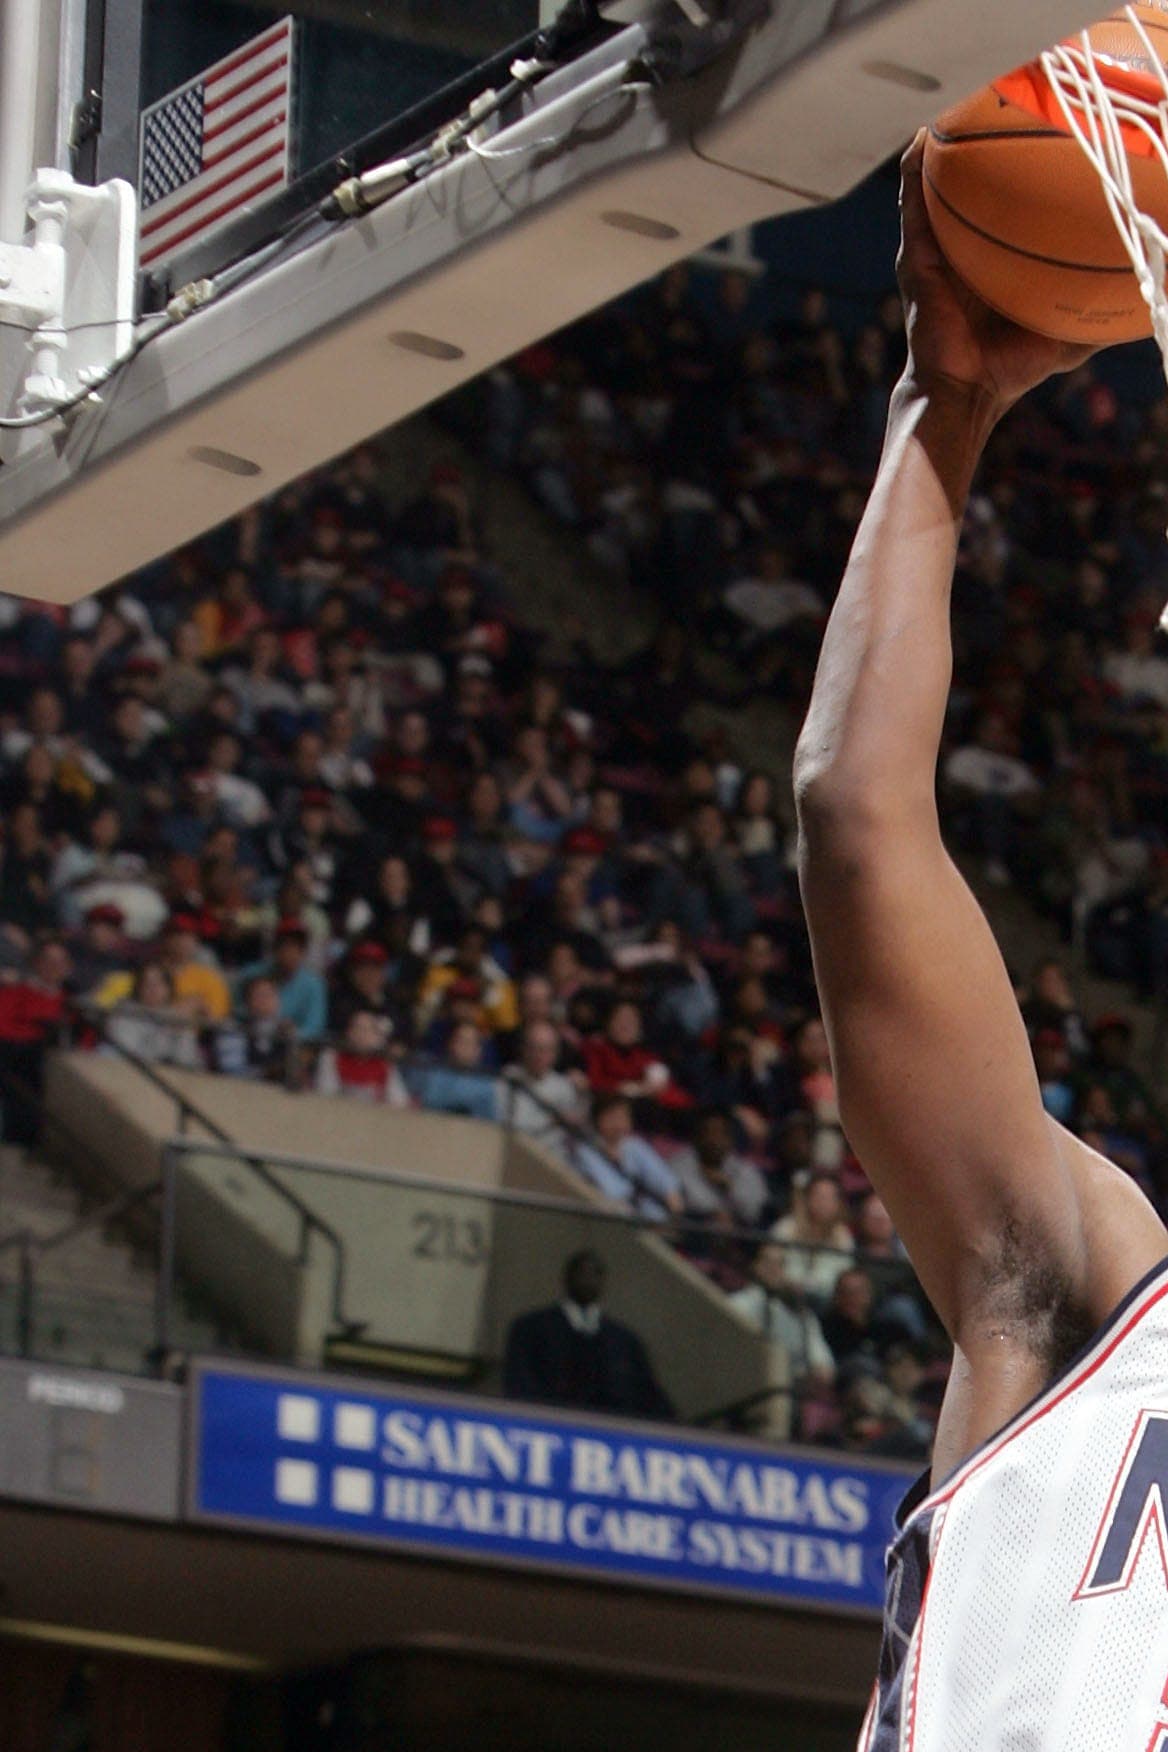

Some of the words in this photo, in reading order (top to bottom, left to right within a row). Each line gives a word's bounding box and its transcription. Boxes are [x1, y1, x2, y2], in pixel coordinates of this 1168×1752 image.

[410, 1210, 489, 1268] 213
[380, 1409, 564, 1487] SAINT
[571, 1435, 870, 1533] BARNABAS
[687, 1519, 863, 1588] SYSTEM
